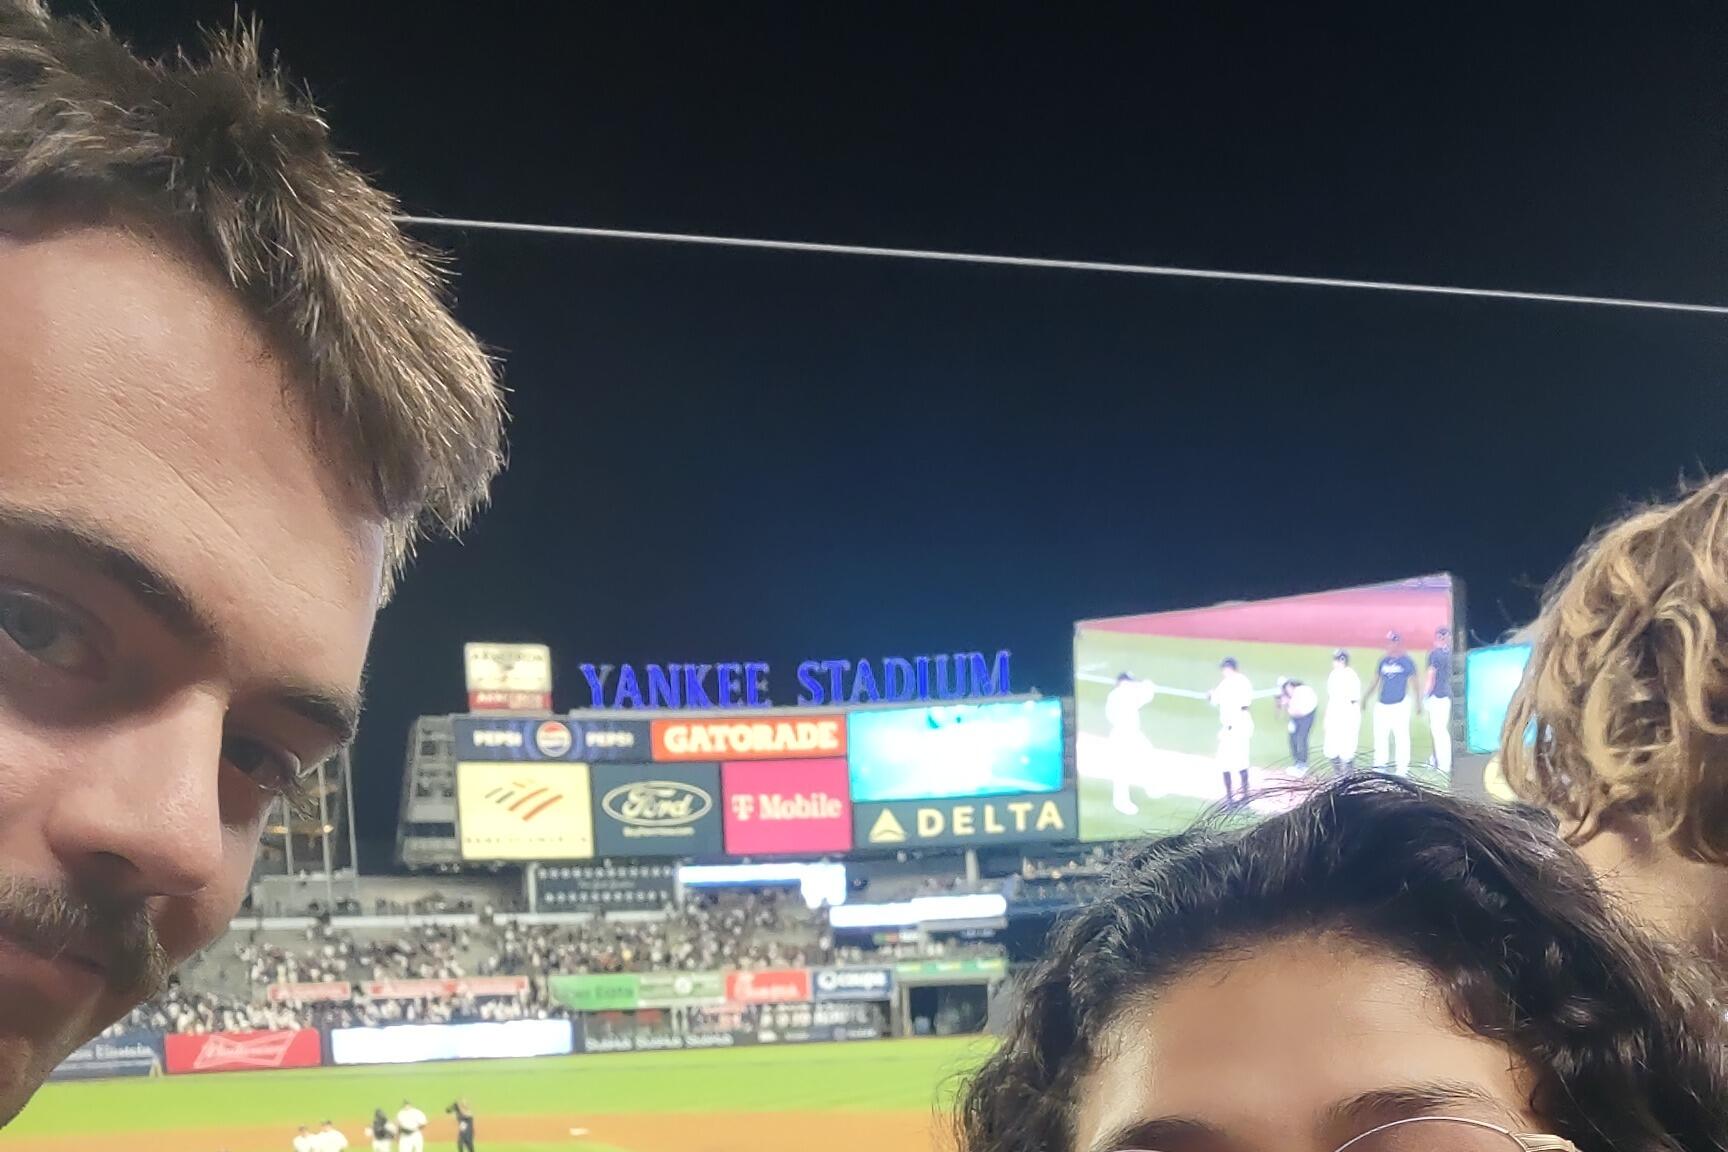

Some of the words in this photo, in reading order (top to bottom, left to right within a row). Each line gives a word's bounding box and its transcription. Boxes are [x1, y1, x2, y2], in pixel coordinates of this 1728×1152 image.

[578, 663, 773, 709] YANKEE
[797, 650, 1011, 706] STADIUM
[473, 729, 522, 748] PEPSI
[664, 721, 838, 752] GATORADE
[621, 786, 693, 818] Ford
[759, 793, 842, 819] Mobile
[917, 801, 1064, 837] DELTA
